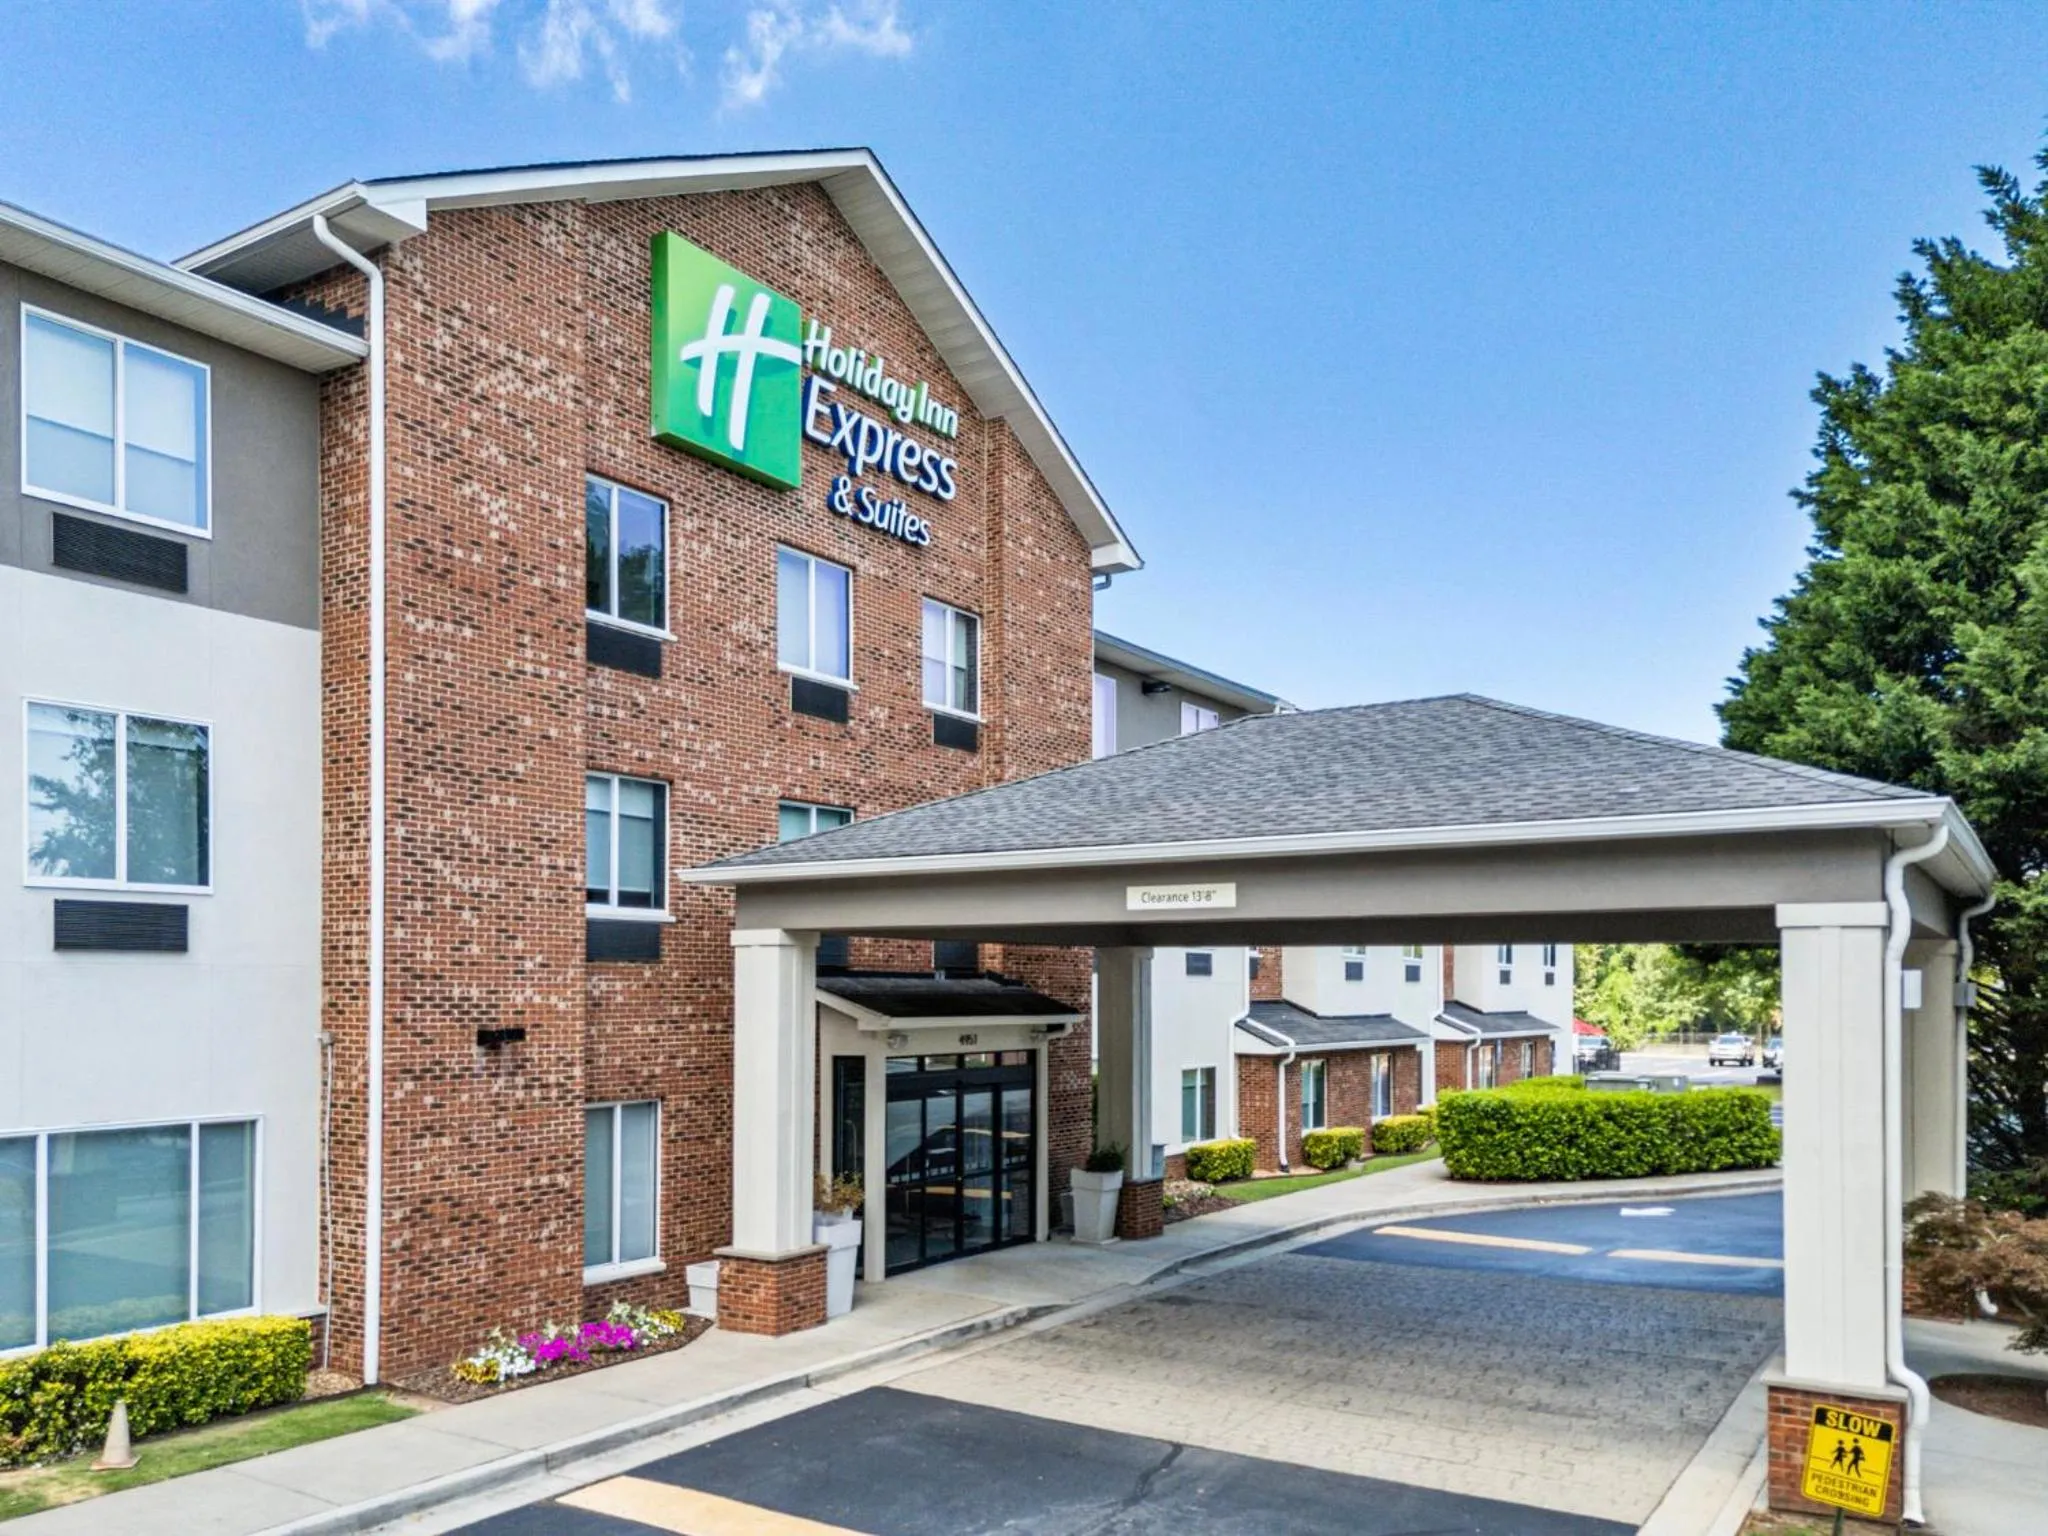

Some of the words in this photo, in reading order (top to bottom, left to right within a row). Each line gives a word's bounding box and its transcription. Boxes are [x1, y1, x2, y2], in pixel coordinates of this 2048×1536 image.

[803, 319, 916, 422] Holiday
[917, 381, 958, 439] Inn
[803, 375, 958, 500] Express
[830, 476, 854, 515] &
[856, 485, 931, 547] Suites
[1141, 891, 1189, 903] Clearance
[1825, 1410, 1881, 1438] SLOW
[1811, 1473, 1877, 1497] PEDESTRIAN
[1815, 1485, 1870, 1507] CROSSING
